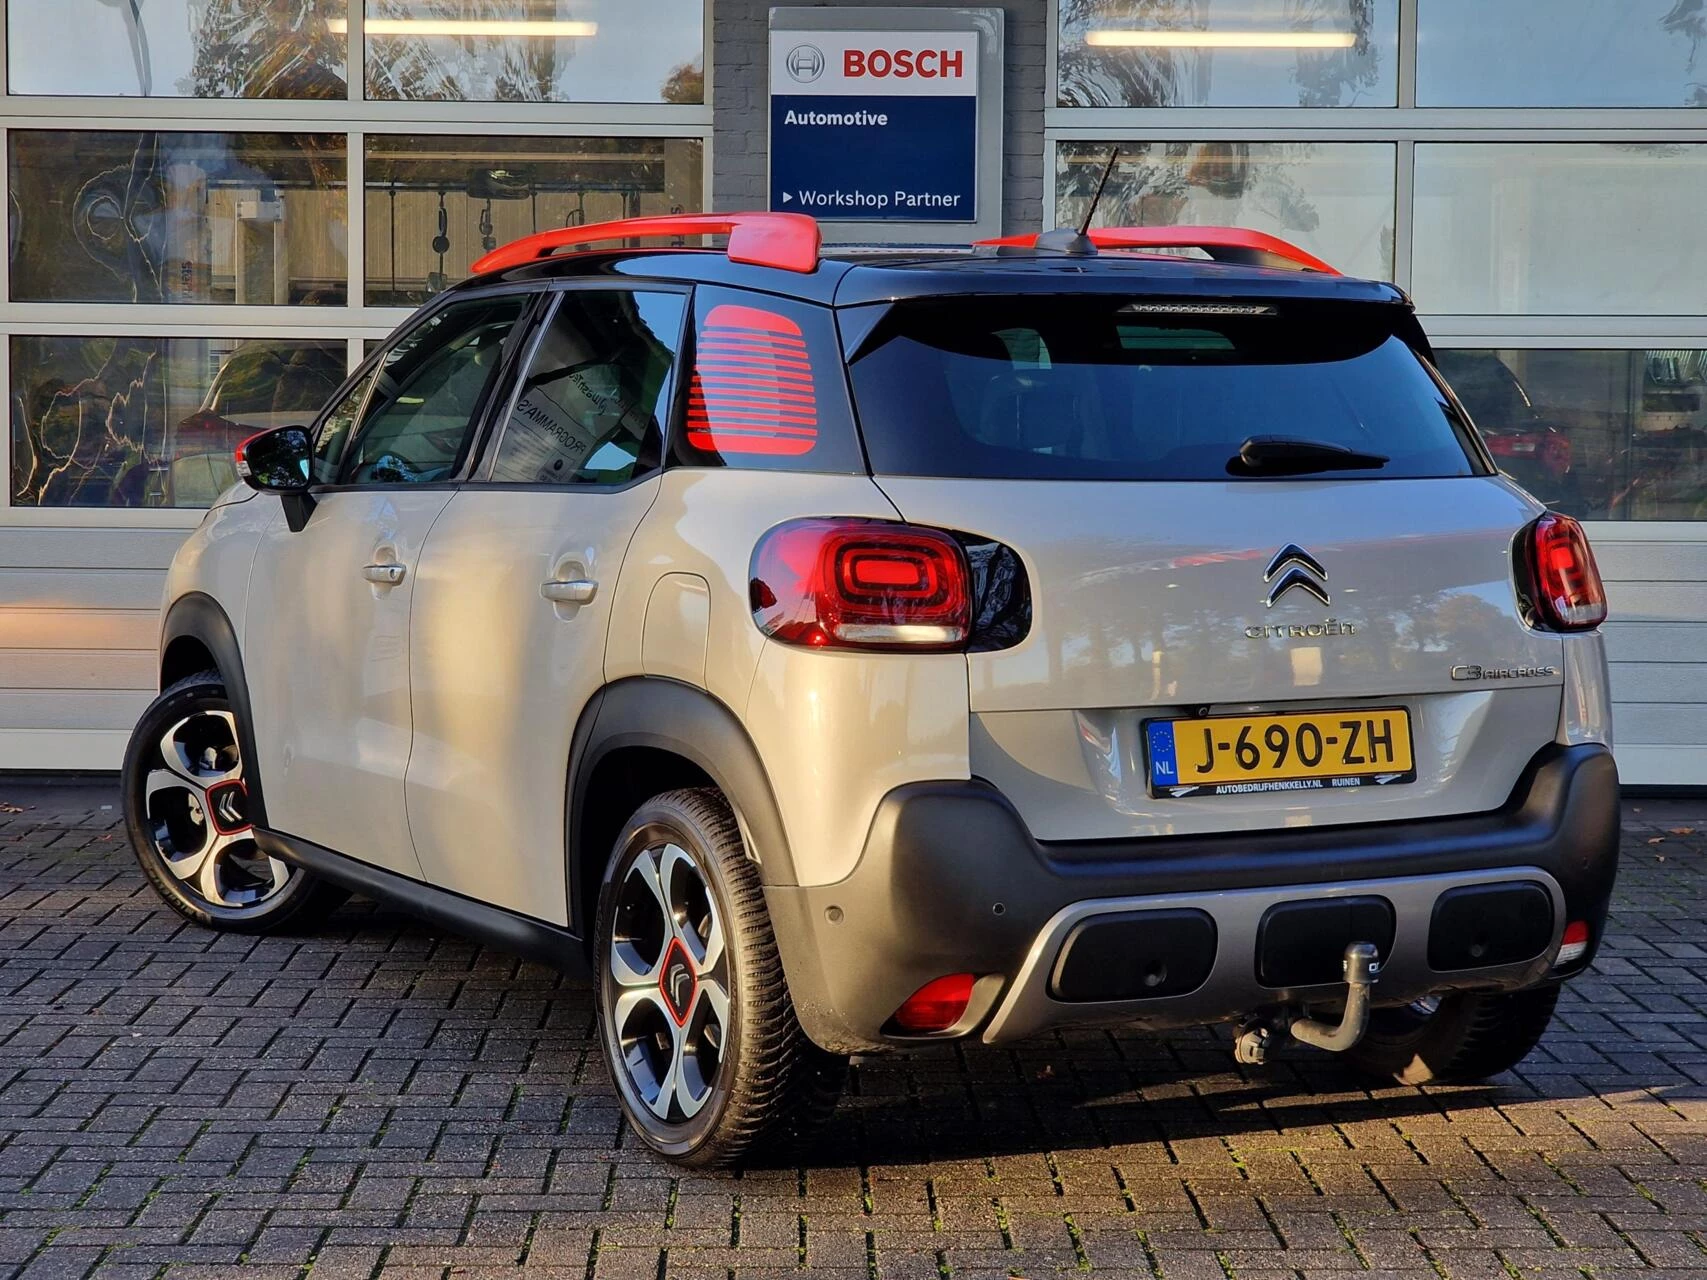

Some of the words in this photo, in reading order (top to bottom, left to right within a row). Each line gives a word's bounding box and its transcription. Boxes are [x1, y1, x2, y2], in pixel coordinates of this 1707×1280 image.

[843, 49, 963, 78] BOSCH
[784, 110, 888, 126] Automotive
[799, 190, 888, 209] Workshop
[894, 191, 961, 207] Partner
[1195, 718, 1394, 774] J-690-ZH
[1155, 760, 1175, 776] NL
[1331, 776, 1361, 788] RUINEN
